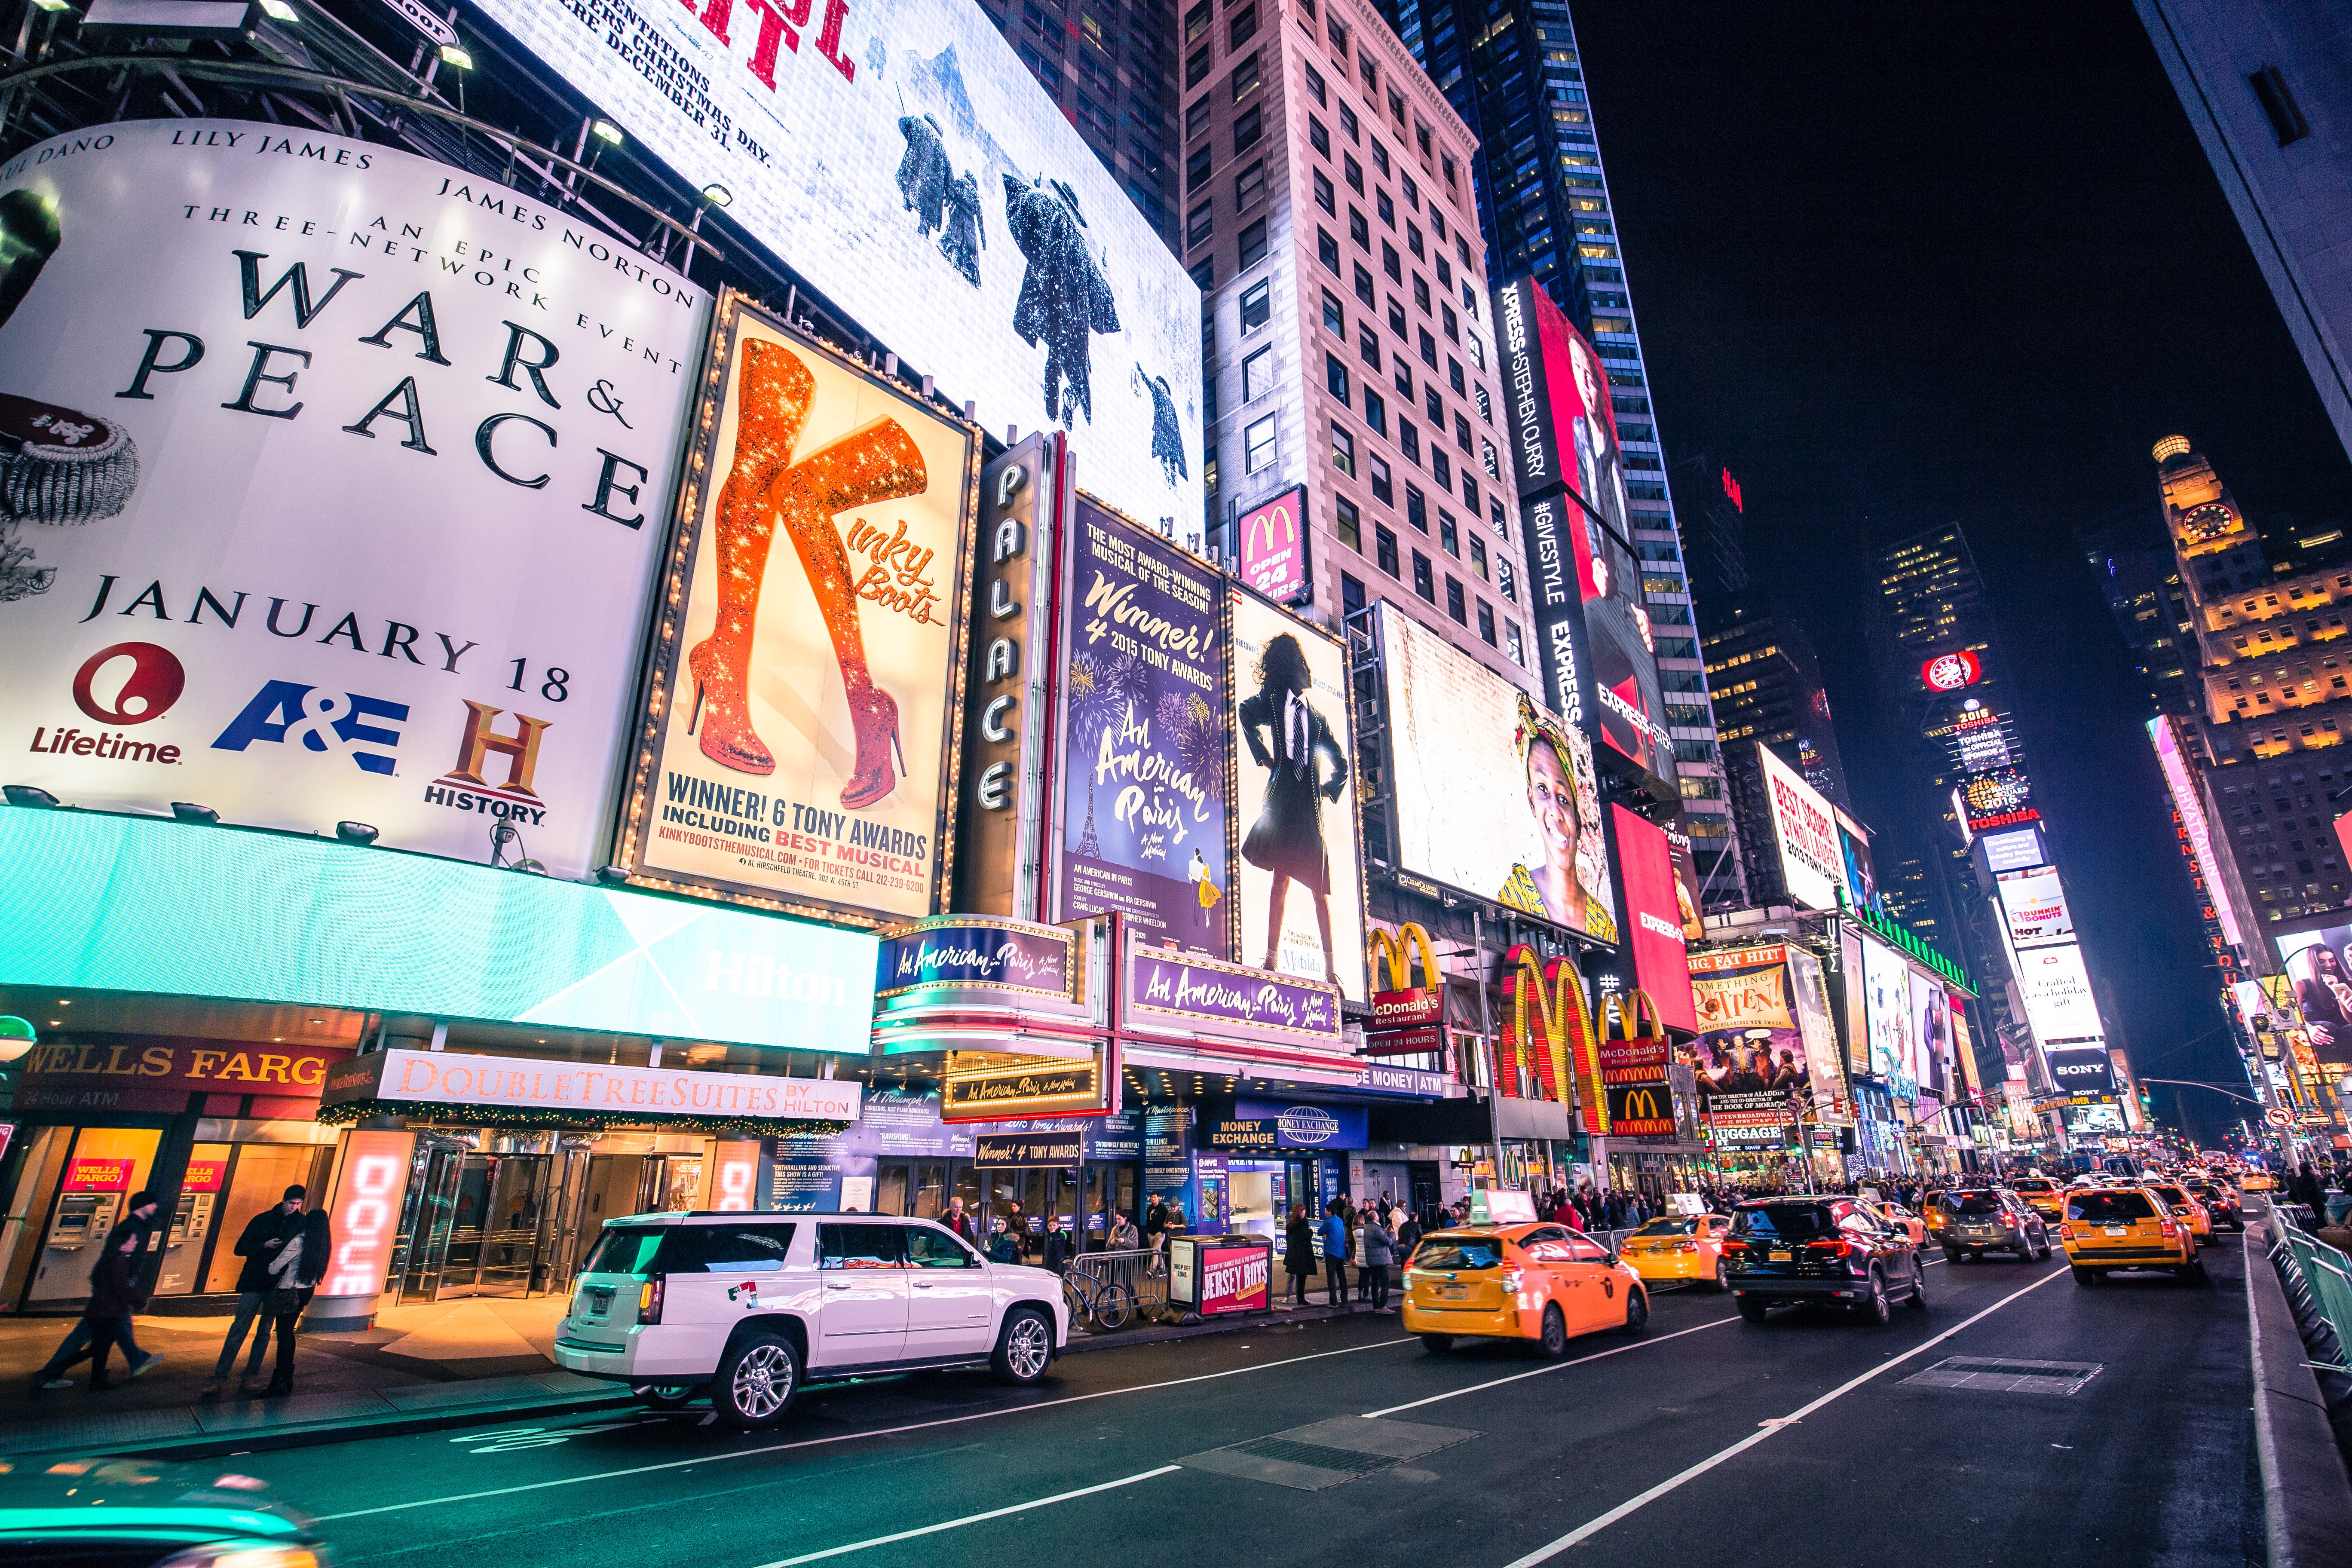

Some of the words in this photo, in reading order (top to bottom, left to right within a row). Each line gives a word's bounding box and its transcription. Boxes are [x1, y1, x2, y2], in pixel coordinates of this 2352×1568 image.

[606, 31, 705, 128] DECEMBER
[710, 129, 731, 152] 31.
[633, 36, 731, 131] CHRISTMAS
[737, 128, 770, 168] DAY.
[37, 135, 114, 164] DANO
[171, 131, 246, 147] LILY
[256, 136, 372, 169] JAMES
[369, 216, 423, 239] AN
[455, 241, 539, 285] EPIC
[437, 178, 545, 230] JAMES
[563, 229, 694, 309] NORTON
[184, 205, 549, 311] THREE-NETWORK
[576, 313, 681, 374] EVENT
[232, 250, 560, 410] WAR
[587, 380, 633, 429] &
[115, 329, 648, 531] PEACE
[1522, 426, 1545, 477] CURRY
[1087, 522, 1107, 542] THE
[1109, 535, 1135, 560] MOST
[1137, 548, 1210, 601] AWARD-WINNING
[1092, 540, 1136, 576] MUSICAL
[1138, 566, 1150, 582] OF
[1152, 573, 1170, 594] THE
[1171, 584, 1208, 615] SEASON!
[1250, 548, 1292, 575] OPEN
[1256, 563, 1288, 593] 24
[856, 563, 946, 626] Boots
[1534, 502, 1565, 605] #GIVESTYLE
[1551, 620, 1583, 723] EXPRESS
[1085, 570, 1213, 663] Winner!
[78, 575, 479, 674] JANUARY
[506, 658, 569, 702] 18
[978, 462, 1027, 811] PALACE
[1085, 619, 1107, 644] 4
[1111, 631, 1138, 655] 2015
[1141, 643, 1169, 673] TONY
[1171, 659, 1213, 691] AWARDS
[1236, 638, 1259, 655] BROADWAY'S
[210, 680, 410, 776] A&E
[1119, 699, 1151, 749] An
[1954, 716, 1998, 730] TOSHIBA
[1959, 708, 1989, 723] 2015
[30, 727, 181, 764] Lifetime
[1958, 730, 2002, 745] TOSHIBA
[1963, 749, 1997, 760] SPONSOR
[1970, 738, 2003, 751] OFFICIAL
[1095, 723, 1209, 825] American
[1154, 782, 1165, 792] in
[424, 786, 547, 825] HISTORY
[668, 771, 766, 822] WINNER!
[773, 799, 785, 826] 6
[793, 803, 846, 840] TONY
[849, 819, 926, 864] AWARDS
[1115, 785, 1188, 845] Paris
[1773, 774, 1801, 821] BEST
[1801, 798, 1835, 847] SCORE!
[1969, 808, 2040, 830] TOSHIBA
[662, 805, 770, 843] INCLUDING
[775, 830, 831, 855] BEST
[836, 845, 925, 878] MUSICAL
[1780, 809, 1810, 852] CYNDI
[1809, 831, 1841, 875] LAUPER
[2176, 785, 2219, 877] #HYATTALLIN
[658, 826, 797, 866] KINKYBOOTSTHEMUSICAL.COM
[804, 851, 819, 870] FOR
[822, 853, 854, 879] TICKETS
[856, 867, 874, 882] CALL
[876, 874, 923, 893] 212-239-6200
[756, 861, 790, 874] HIRSCHFELD
[818, 873, 828, 882] 302
[1074, 864, 1081, 873] AN
[1083, 866, 1110, 880] AMERICAN
[1112, 873, 1117, 882] IN
[1118, 875, 1132, 886] PARIS
[1787, 839, 1804, 864] 2013
[1804, 852, 1822, 876] TONY
[2172, 811, 2203, 889] ERNST
[2204, 907, 2216, 919] &
[1073, 901, 1088, 911] CRAIG
[1089, 904, 1104, 914] LUCAS
[1074, 883, 1093, 894] GEORGE
[1094, 888, 1118, 901] GERSHWIN
[1133, 897, 1156, 910] GERSHWIN
[2024, 905, 2062, 916] DUNKIN'
[1143, 918, 1166, 929] WHEELDON
[2025, 912, 2062, 922] DONUTS
[913, 941, 991, 977] American
[997, 942, 1034, 979] Paris
[1283, 949, 1321, 972] Matilda
[1714, 954, 1741, 967] FAT
[1904, 929, 1965, 986] BROADWAY
[703, 949, 845, 1006] Hilton
[1145, 965, 1170, 1001] An
[1175, 967, 1254, 1019] American
[1257, 985, 1297, 1026] Paris
[1375, 999, 1439, 1015] cDonald's
[1376, 1013, 1425, 1024] Restaurant
[1369, 1040, 1390, 1049] OPEN
[1406, 1035, 1435, 1044] HOURS
[1600, 1045, 1664, 1058] McDonald's
[1612, 1056, 1655, 1064] Restaurant
[27, 1045, 174, 1076] WELLS
[185, 1048, 327, 1085] FARG
[1373, 1071, 1413, 1088] MONEY
[1420, 1077, 1441, 1091] ATM
[2057, 1064, 2104, 1075] SONY
[80, 1092, 119, 1106] ATM
[784, 1099, 848, 1113] HILTON
[786, 1085, 811, 1097] BY
[1213, 1133, 1274, 1143] EXCHANGE
[1222, 1121, 1261, 1131] MONEY
[1302, 1120, 1338, 1131] EXCHANGE
[1707, 1127, 1781, 1140] LUGGAGE
[977, 1142, 1013, 1160] Winner!
[1017, 1145, 1026, 1160] 4
[1030, 1146, 1047, 1158] TONY
[1049, 1145, 1078, 1158] AWARDS
[77, 1166, 120, 1174] WELLS
[1203, 1266, 1241, 1301] JERSEY
[1243, 1259, 1268, 1288] BOYS
